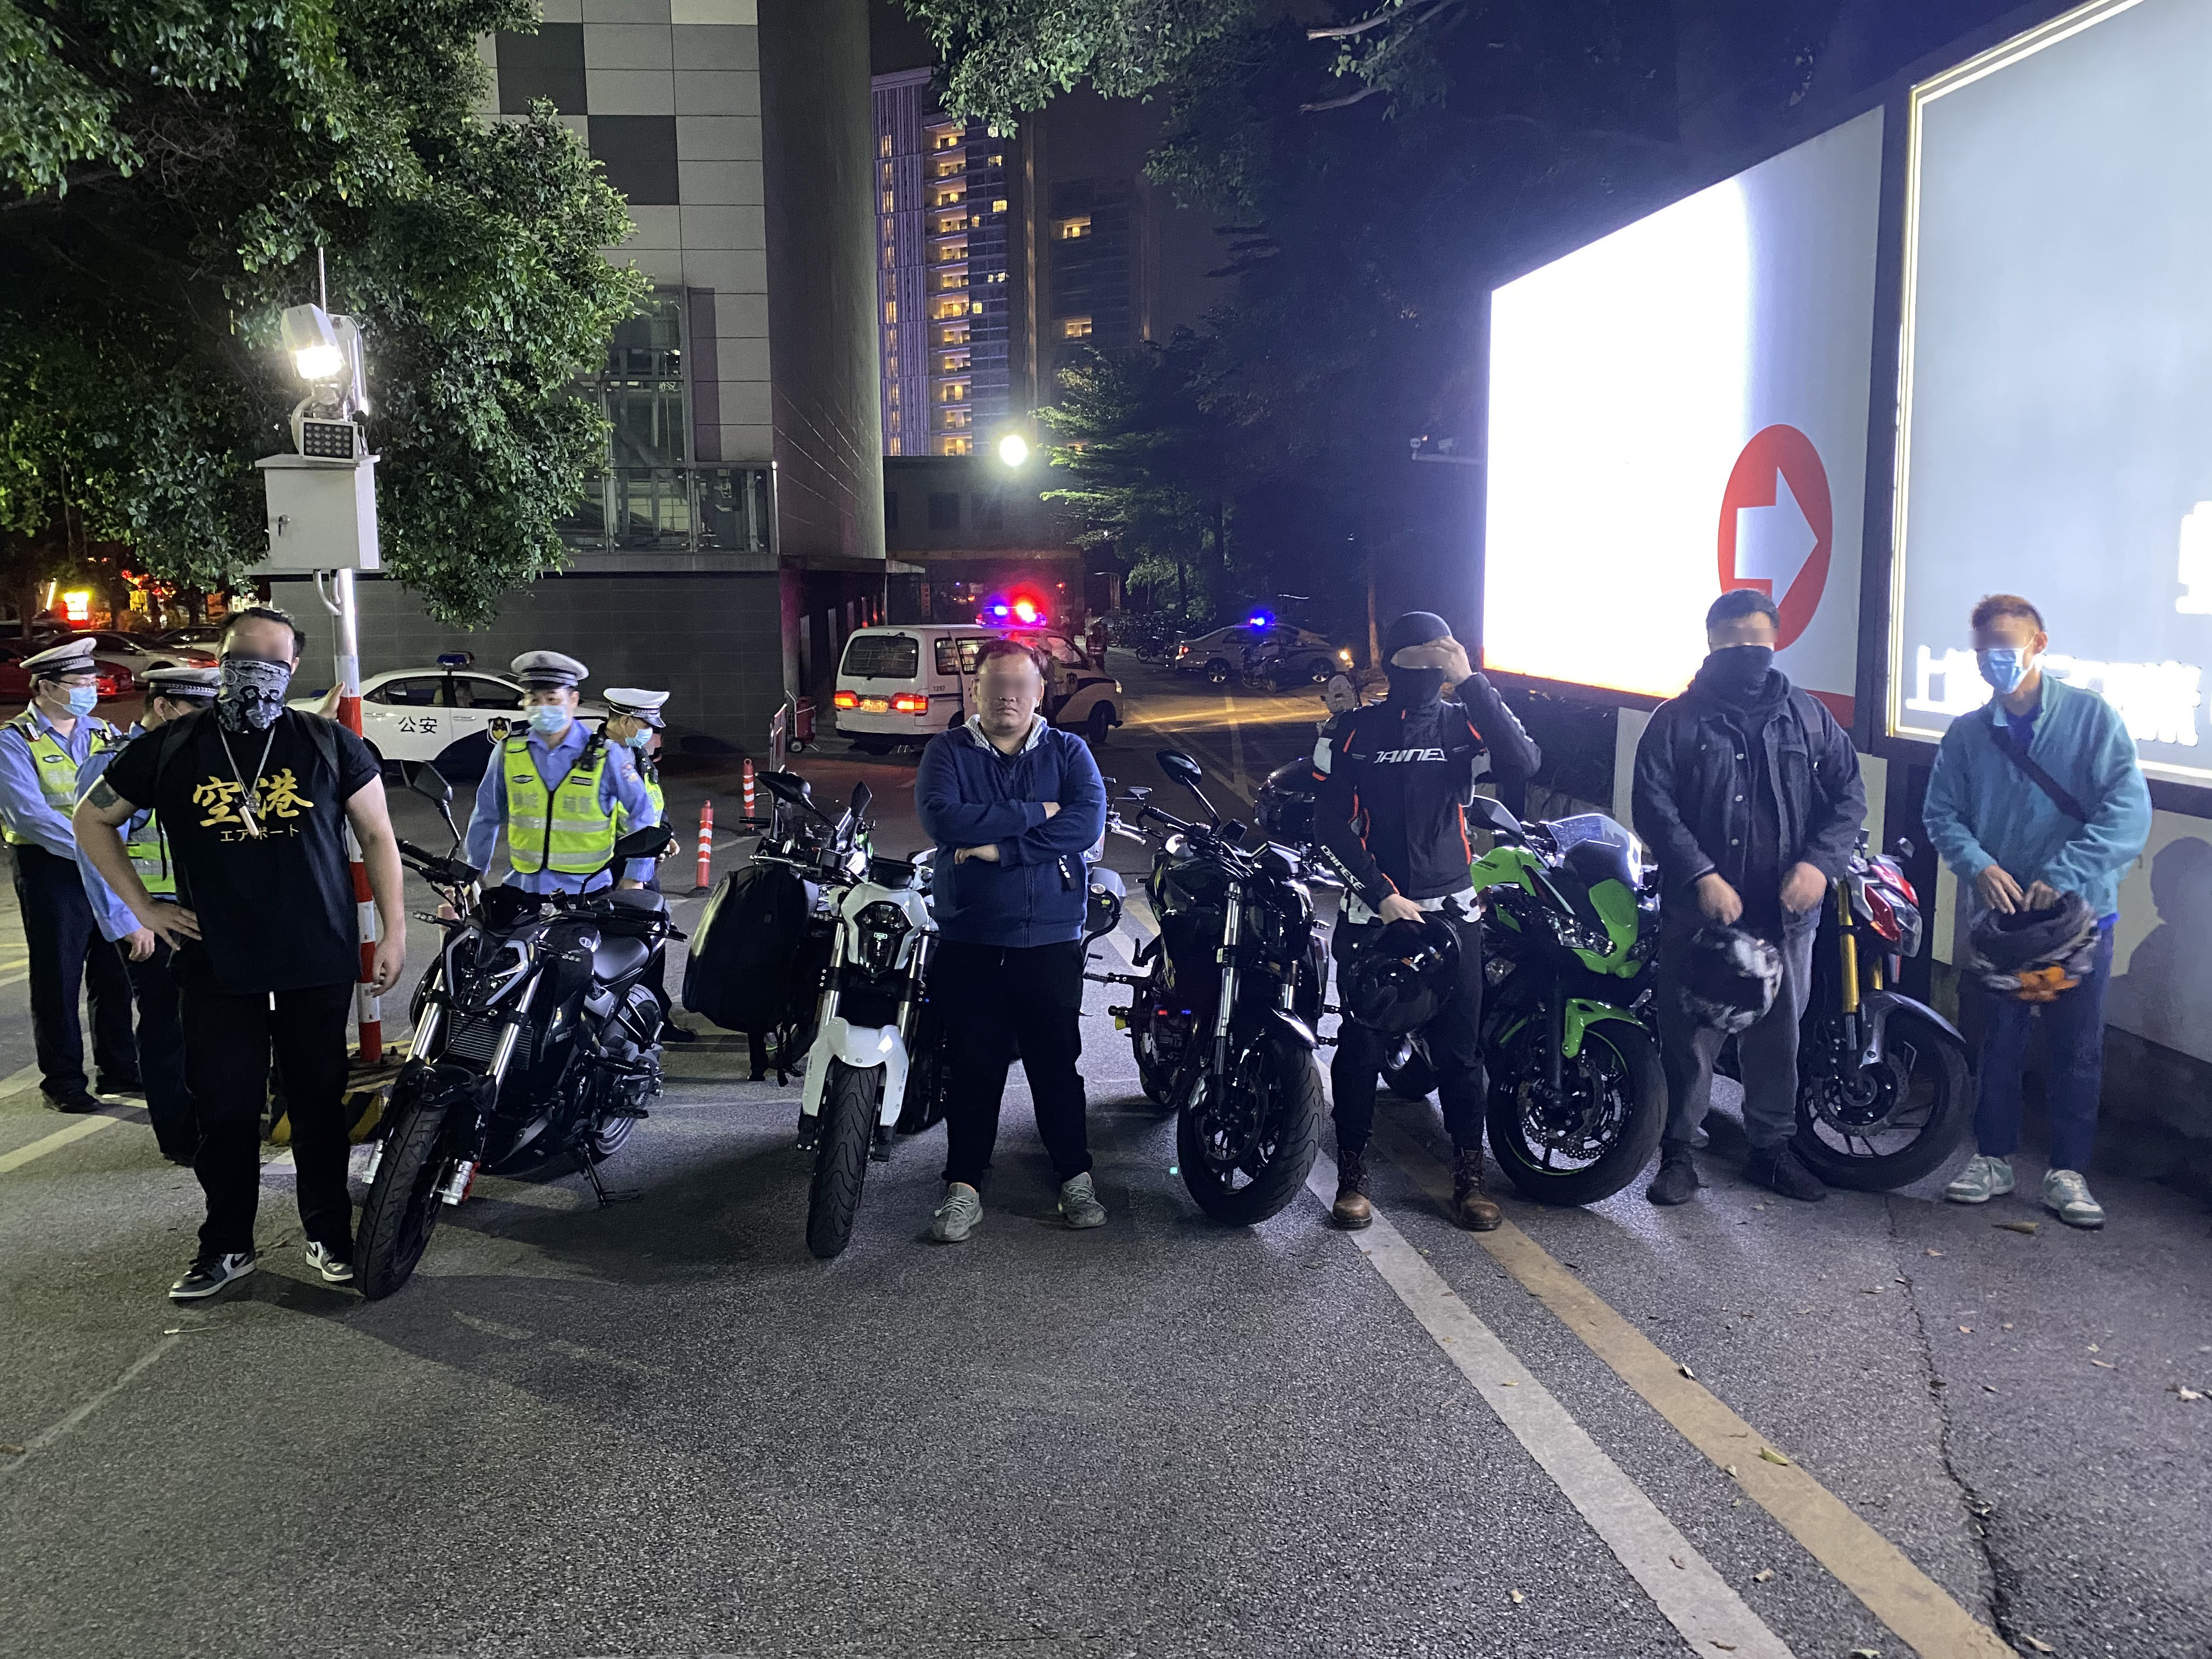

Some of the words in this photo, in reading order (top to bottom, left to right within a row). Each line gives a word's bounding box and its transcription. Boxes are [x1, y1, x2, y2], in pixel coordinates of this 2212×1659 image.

[398, 715, 438, 734] 公安
[193, 768, 314, 827] 空港
[1320, 845, 1366, 891] DAINESE
